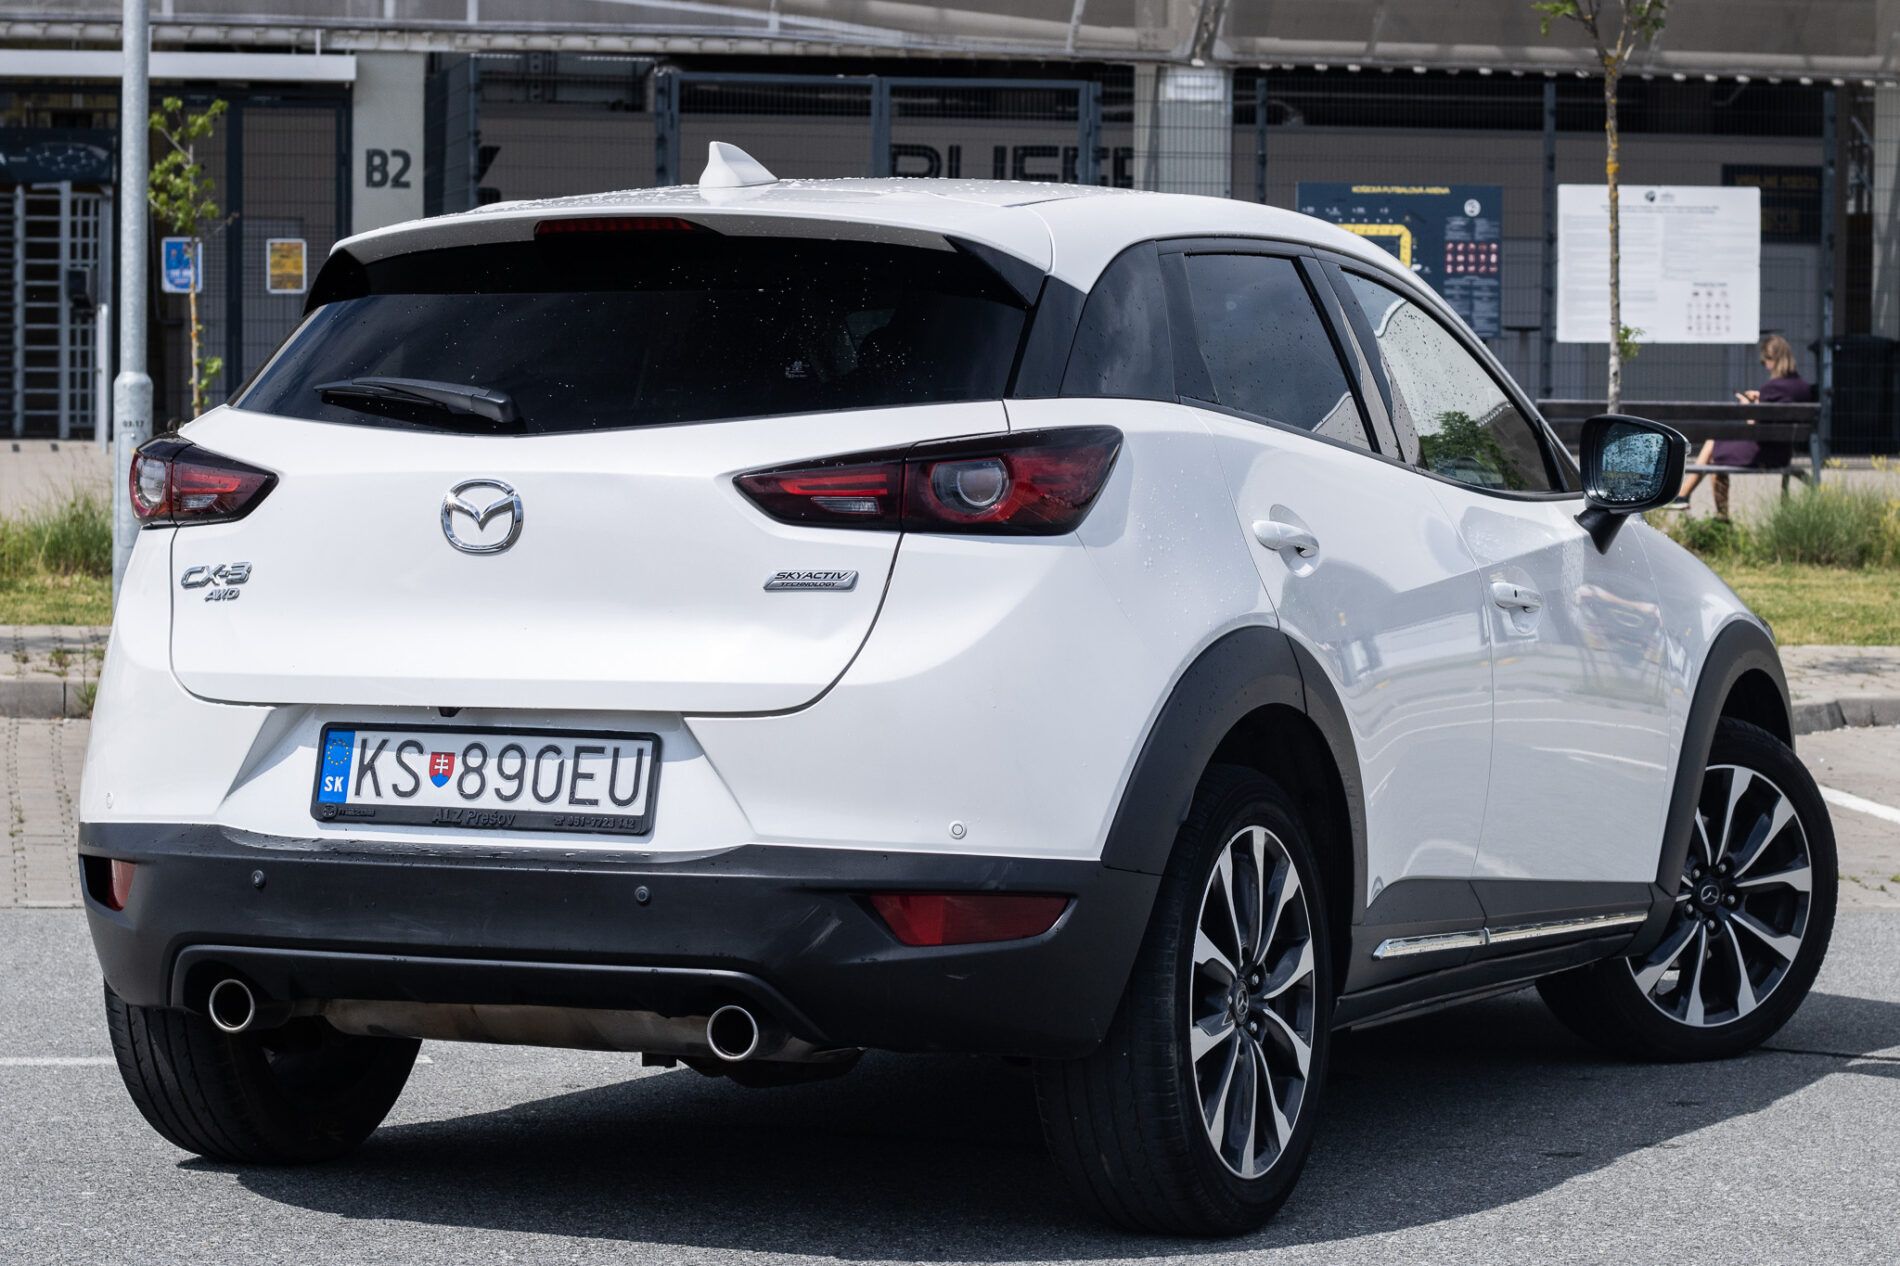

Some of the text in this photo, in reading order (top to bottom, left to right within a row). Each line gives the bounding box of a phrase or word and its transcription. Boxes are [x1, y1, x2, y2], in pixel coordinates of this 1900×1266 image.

[366, 148, 411, 188] B2
[181, 562, 252, 589] CX-3
[774, 571, 848, 579] SKYACTIV
[204, 588, 240, 602] AWD
[354, 738, 645, 807] KS 890EU
[323, 775, 343, 793] SK
